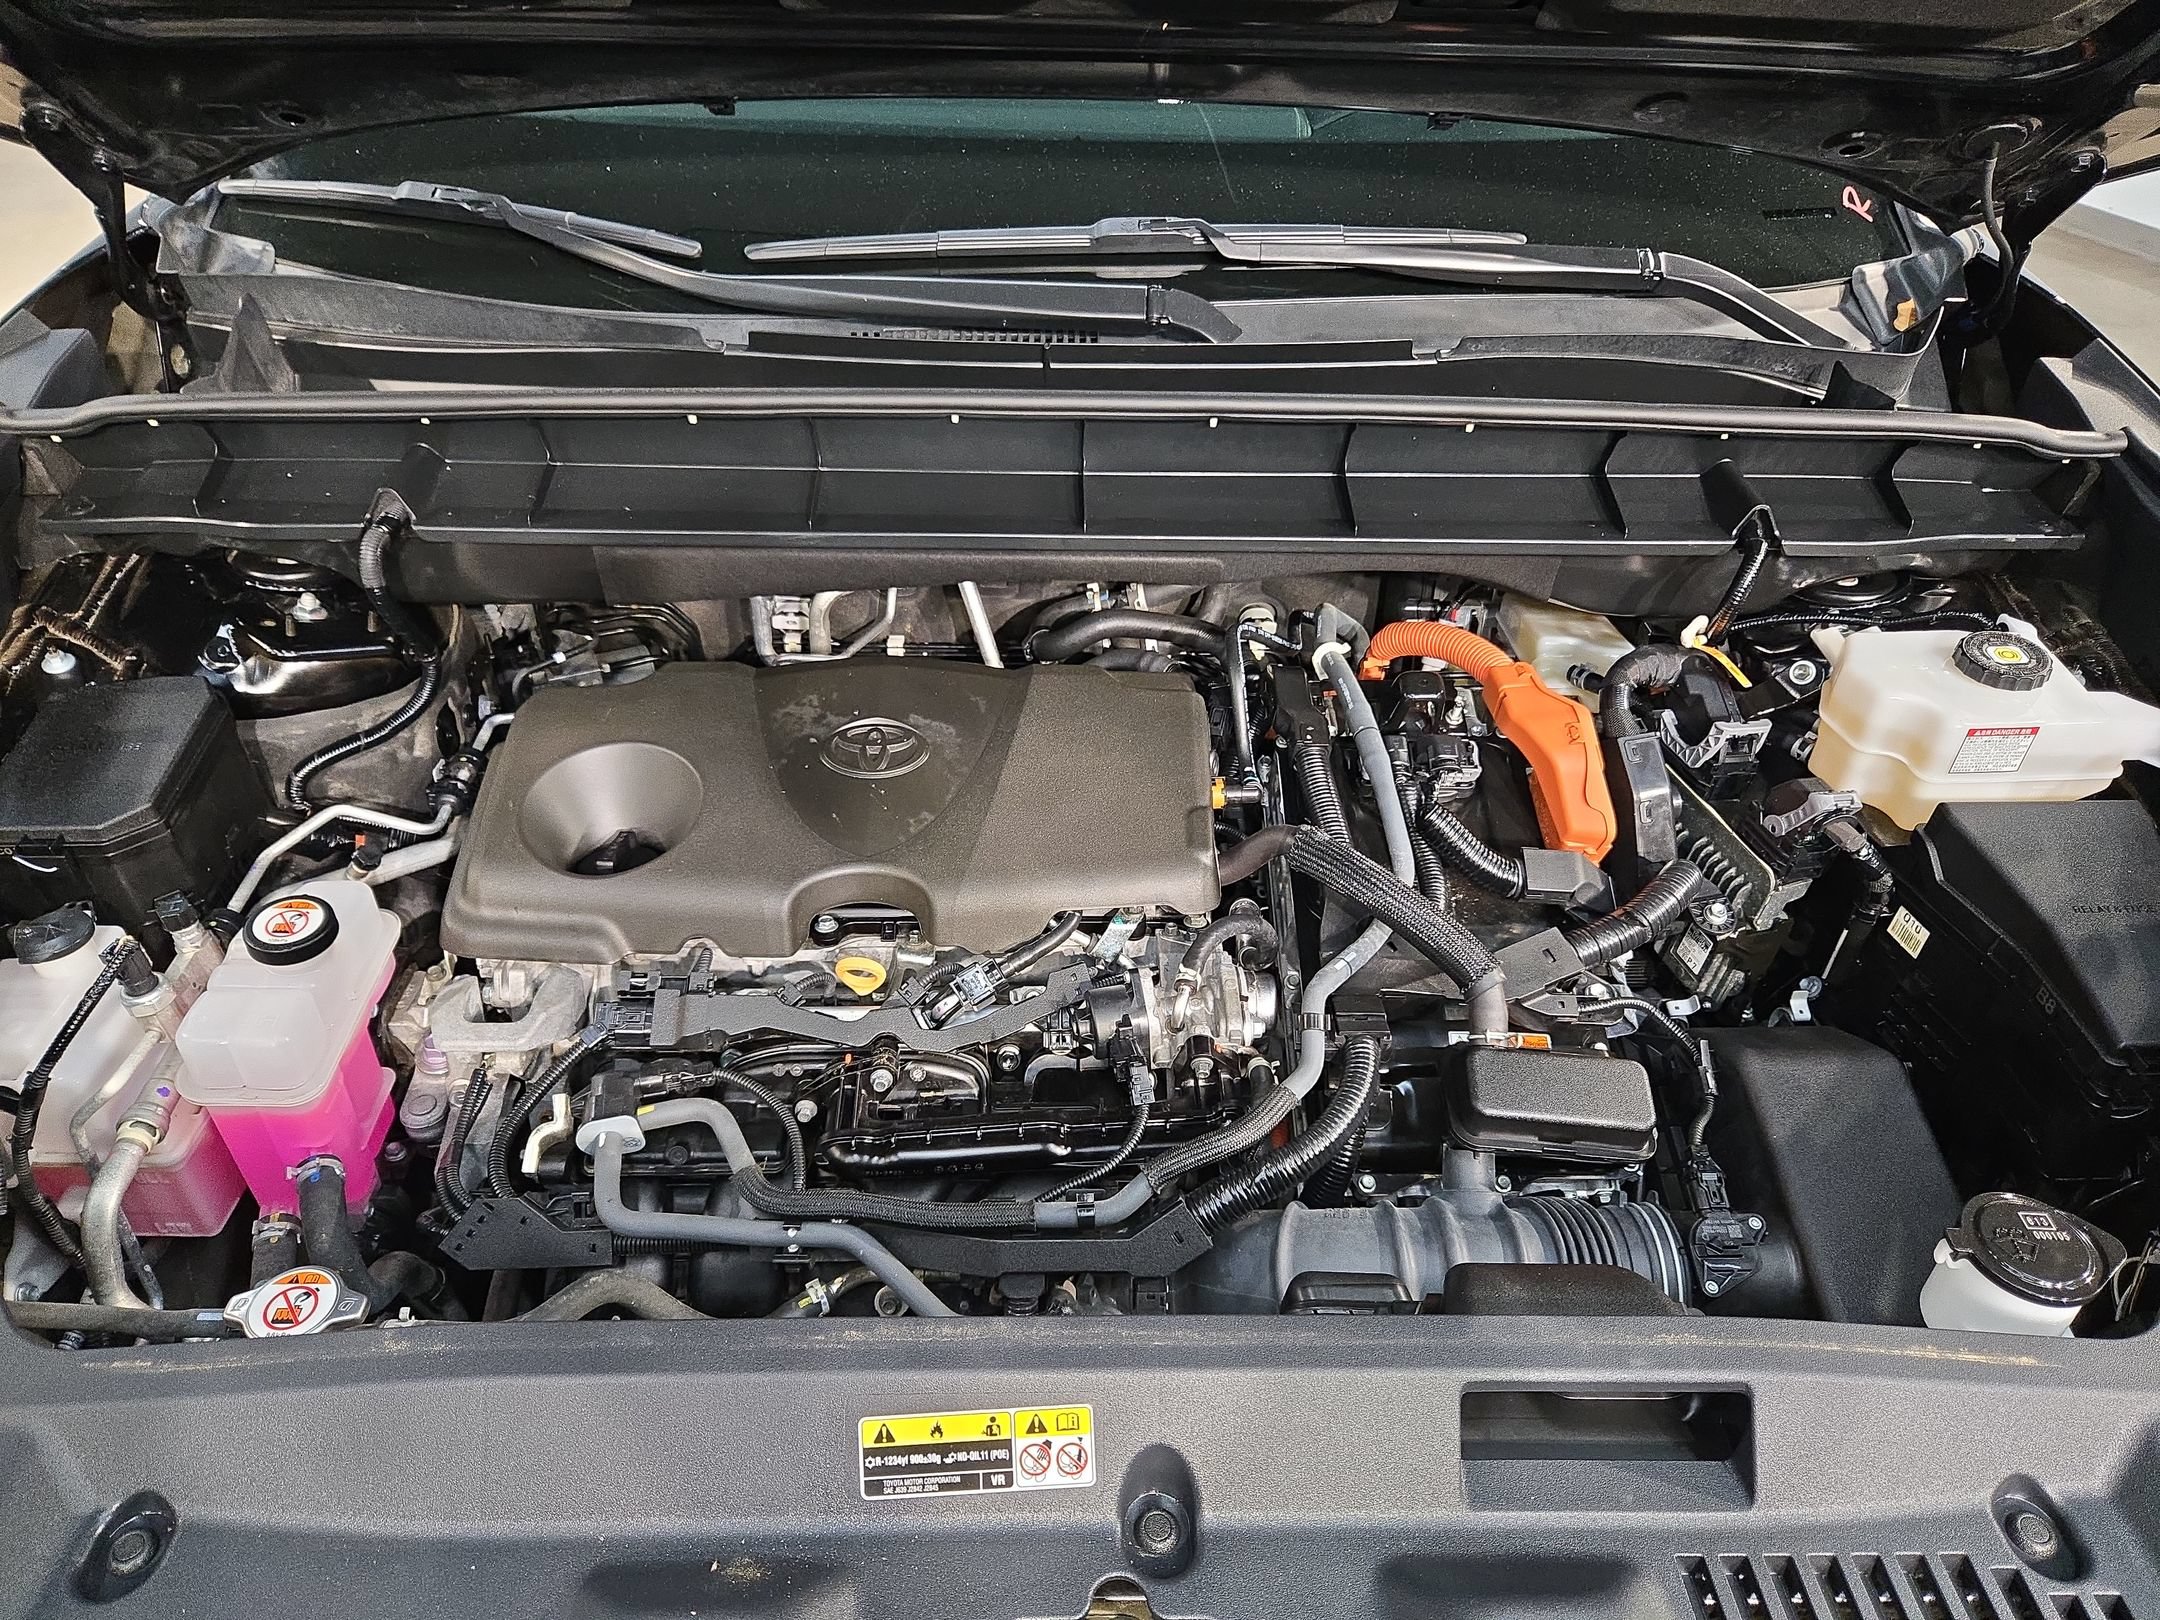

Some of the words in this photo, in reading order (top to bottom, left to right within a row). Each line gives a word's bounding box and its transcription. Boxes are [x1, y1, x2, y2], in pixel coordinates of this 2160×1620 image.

[1842, 186, 1873, 223] R
[1991, 728, 2020, 736] DANGER
[2072, 905, 2111, 914] RELAY
[2035, 987, 2057, 1015] B8
[2032, 1230, 2071, 1242] 000105
[875, 1454, 908, 1468] R-1234yf
[957, 1450, 989, 1462] ND-OIL11
[990, 1448, 1010, 1462] (POE)
[883, 1479, 904, 1487] TOYOTA
[904, 1477, 924, 1485] MOTOR
[924, 1475, 961, 1484] CORPORATION
[990, 1473, 1006, 1486] VR
[883, 1486, 894, 1495] SAE
